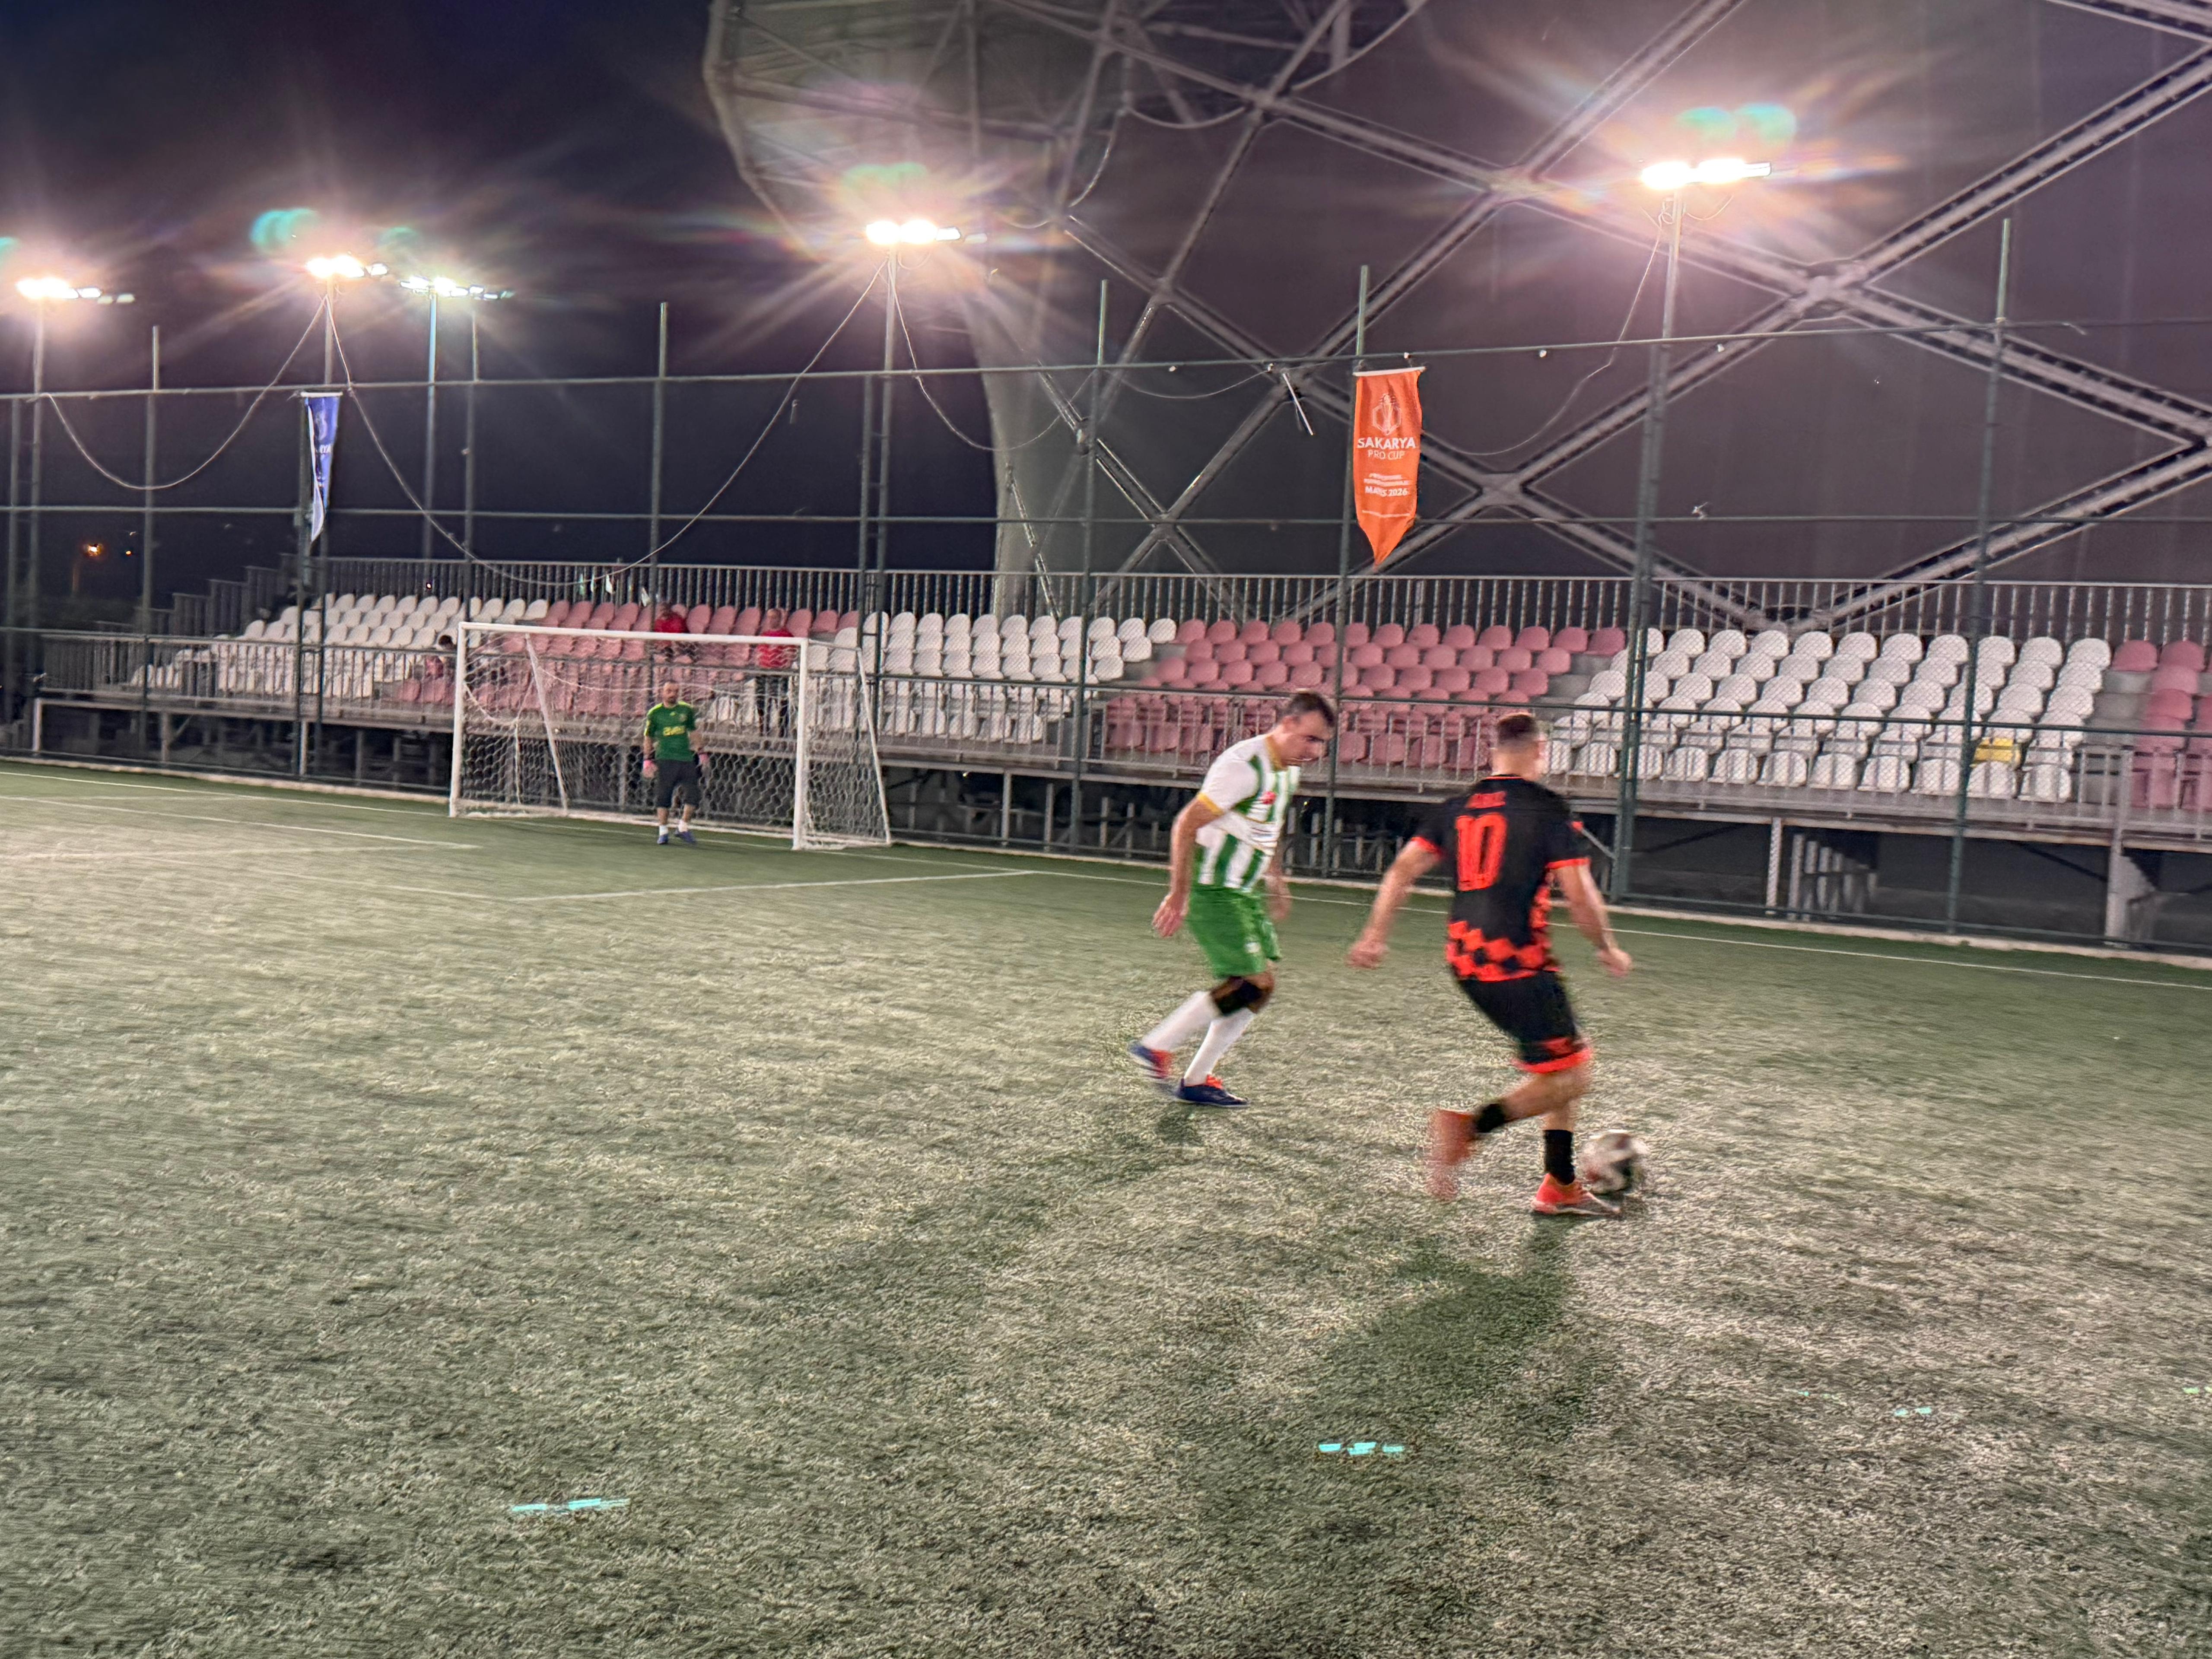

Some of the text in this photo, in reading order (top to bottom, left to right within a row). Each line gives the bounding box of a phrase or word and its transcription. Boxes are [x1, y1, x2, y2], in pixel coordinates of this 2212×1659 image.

[1357, 437, 1416, 449] SAKARYA
[1368, 449, 1405, 460] PRO CUP
[1388, 488, 1409, 497] 2026
[1456, 812, 1506, 891] 10
